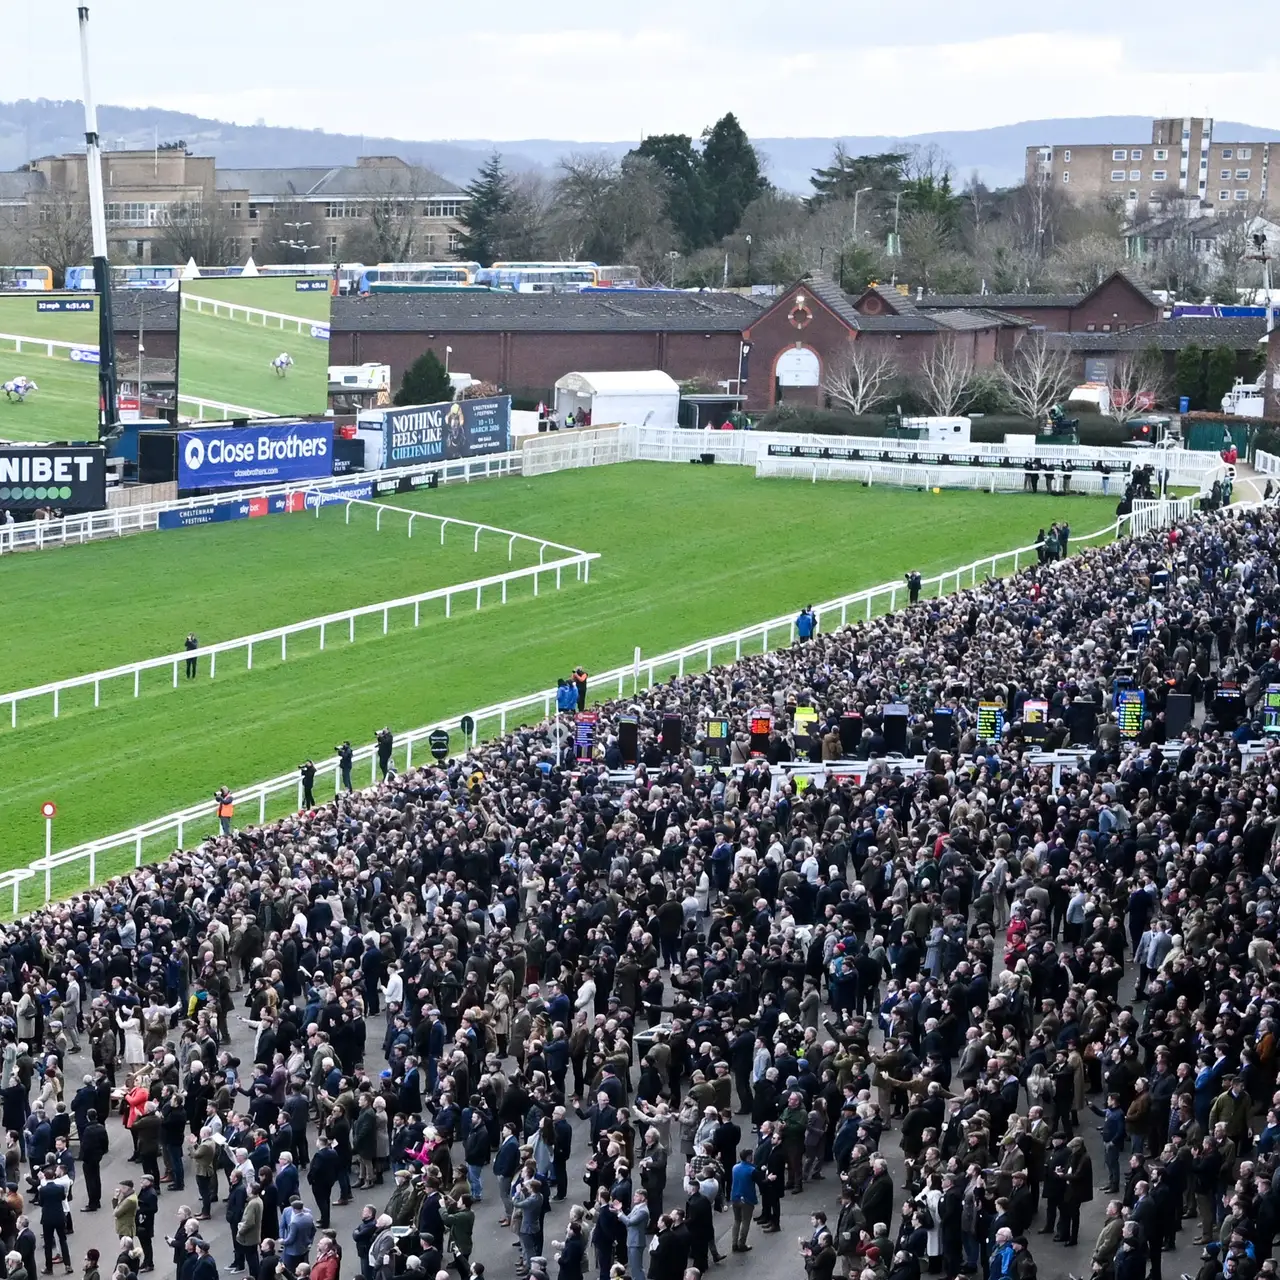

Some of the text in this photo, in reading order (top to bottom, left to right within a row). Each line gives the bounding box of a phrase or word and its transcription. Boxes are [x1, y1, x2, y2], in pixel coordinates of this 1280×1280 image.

[392, 410, 443, 434] NOTHING
[392, 428, 443, 447] FEELS LIKE
[207, 434, 327, 464] Close Brothers
[392, 442, 443, 461] CHELTENHAM
[770, 445, 797, 453] UNIBET
[799, 446, 826, 454] UNIBET
[828, 448, 855, 456] UNIBET
[858, 449, 886, 458] UNIBET
[888, 450, 915, 459] UNIBET
[917, 452, 944, 460] UNIBET
[948, 454, 976, 462] UNIBET
[978, 455, 1006, 463] UNIBET
[1071, 459, 1099, 467] UNIBET
[234, 467, 279, 478] closebrothers.com
[377, 473, 434, 492] UNIBET UNIBET
[179, 508, 215, 518] CHELTENHAM
[240, 502, 260, 515] sky bet
[275, 499, 285, 510] sky
[185, 516, 209, 525] FESTIVAL
